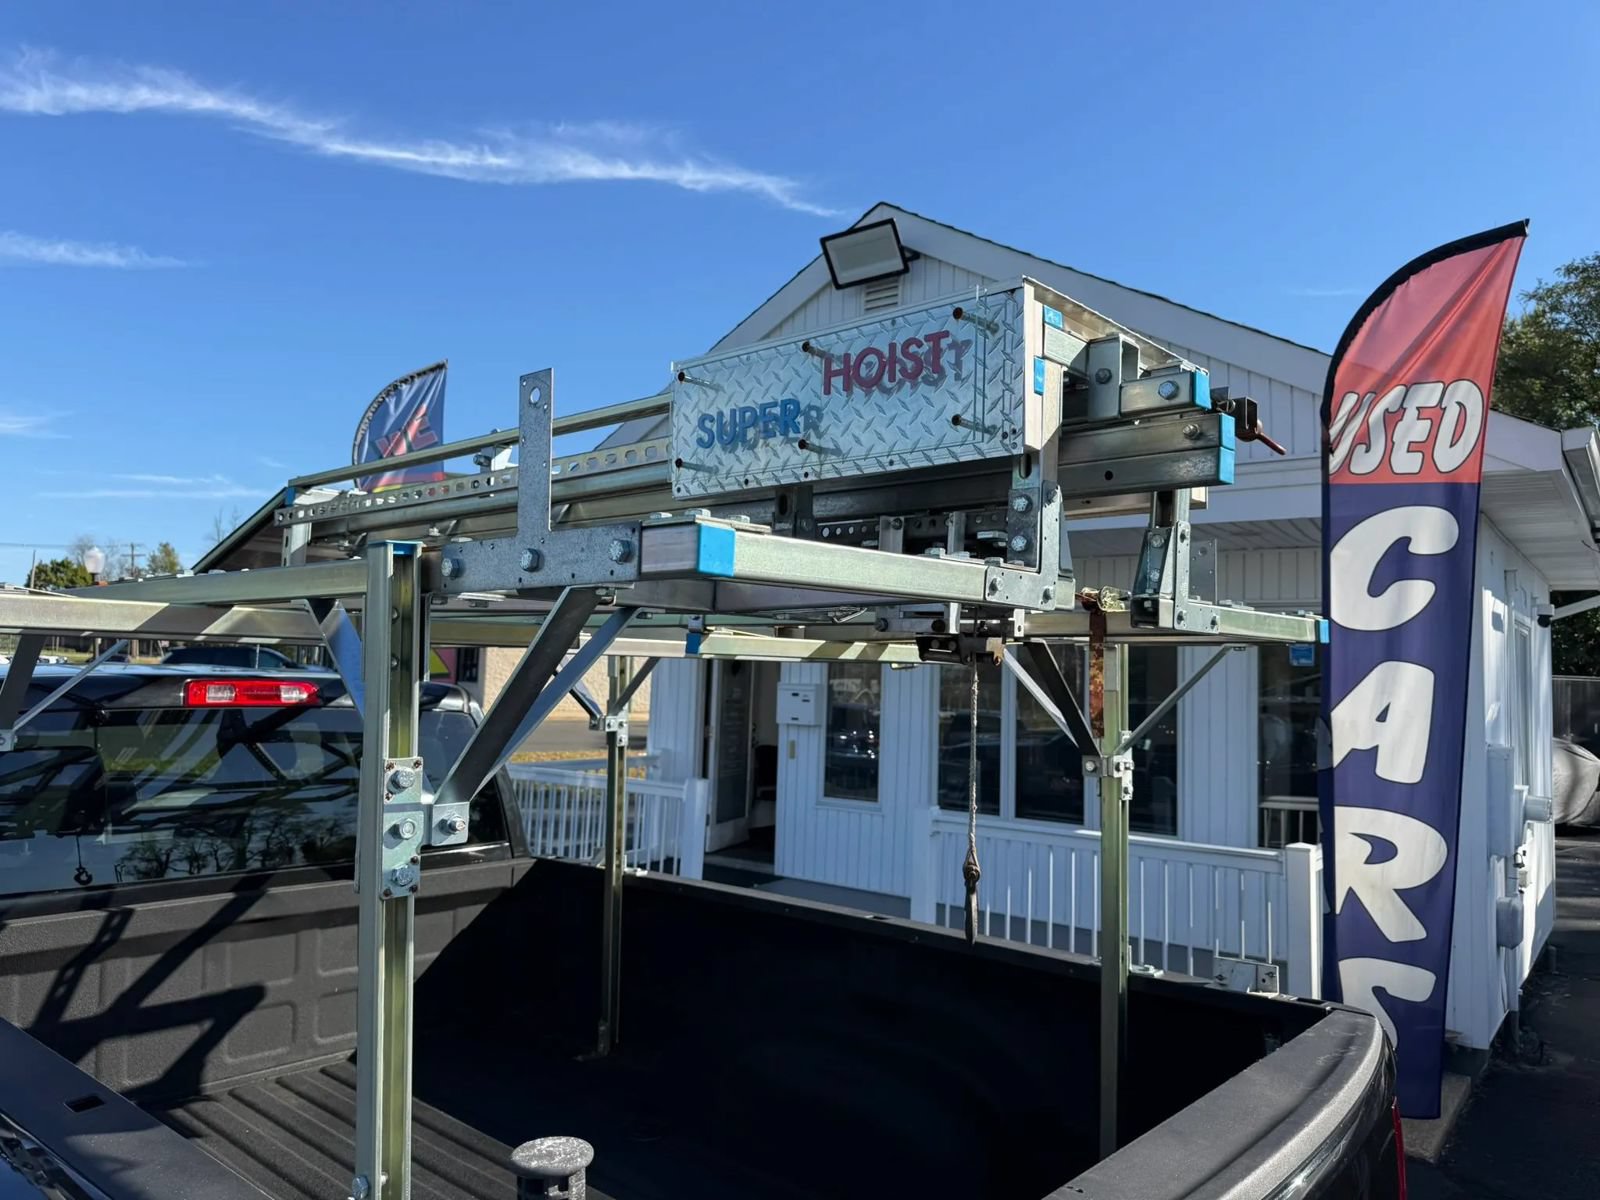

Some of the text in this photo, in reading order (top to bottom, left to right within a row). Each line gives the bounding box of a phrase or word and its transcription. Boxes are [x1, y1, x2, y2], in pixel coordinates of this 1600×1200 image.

[823, 330, 950, 396] HOIST
[696, 398, 802, 449] SUPER
[1329, 379, 1484, 475] USED
